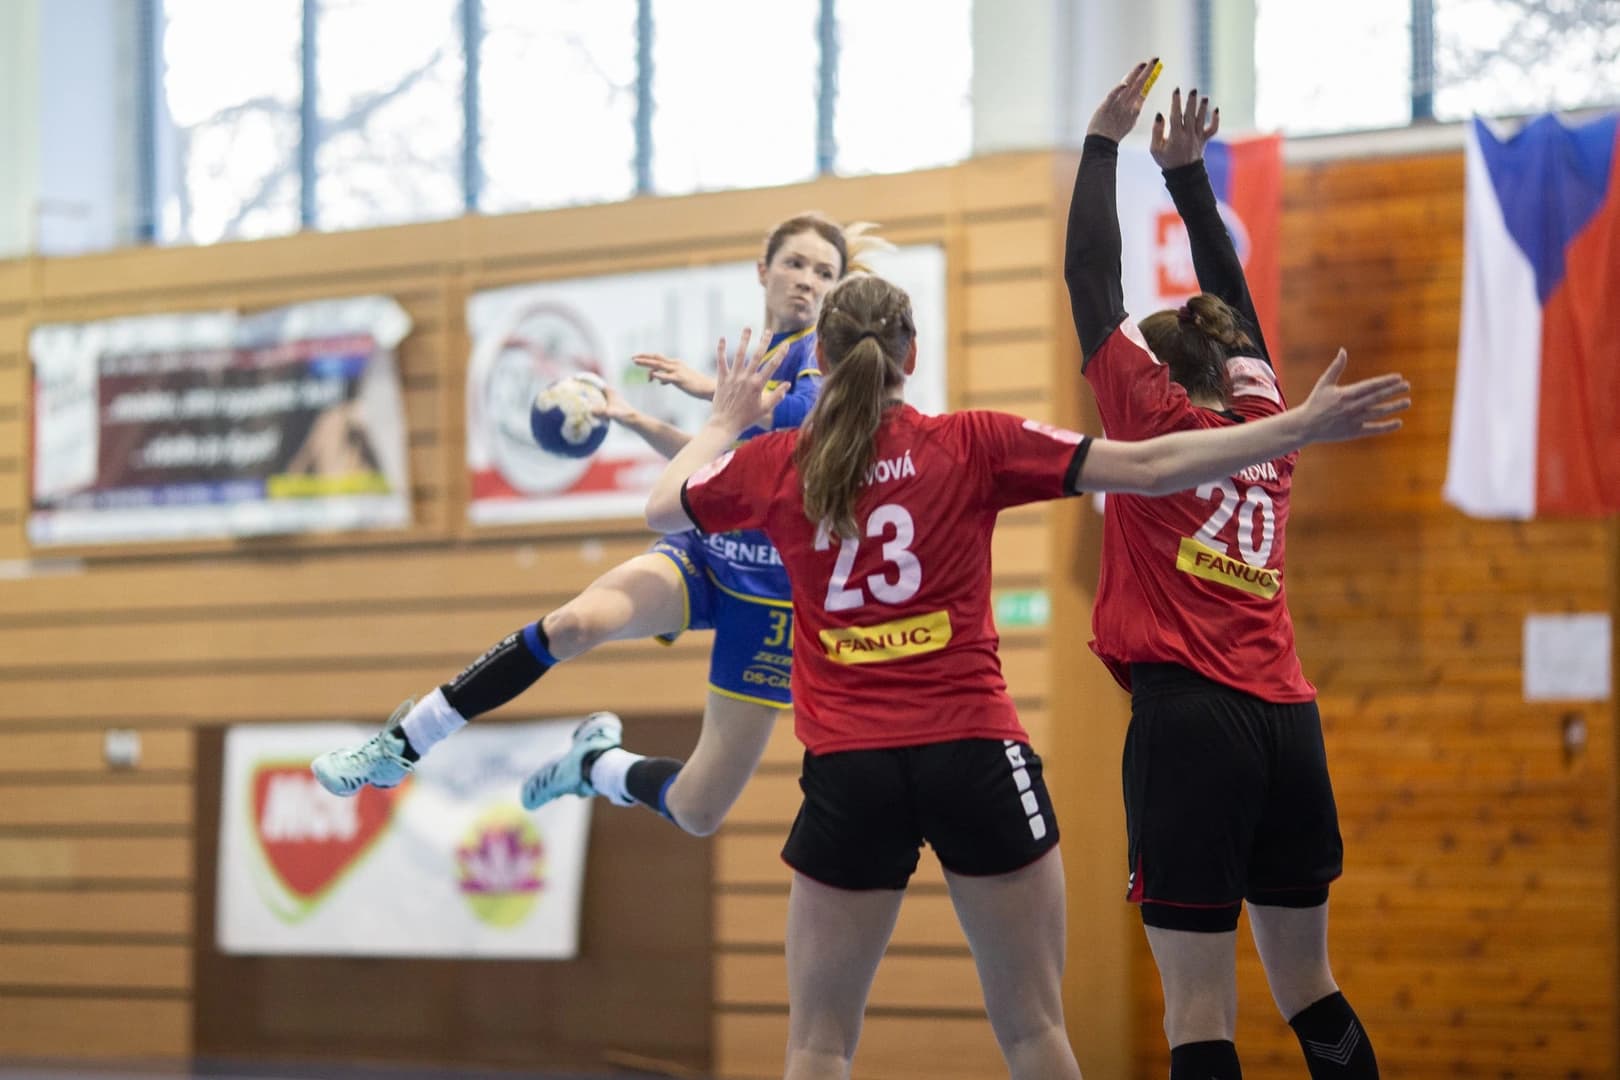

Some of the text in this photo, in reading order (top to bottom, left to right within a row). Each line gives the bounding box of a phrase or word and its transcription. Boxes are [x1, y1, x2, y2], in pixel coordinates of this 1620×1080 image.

[860, 449, 916, 487] VOVÁ
[1192, 479, 1275, 568] 20
[814, 503, 922, 613] 23
[1195, 551, 1274, 587] FANUC
[835, 627, 931, 656] FANUC
